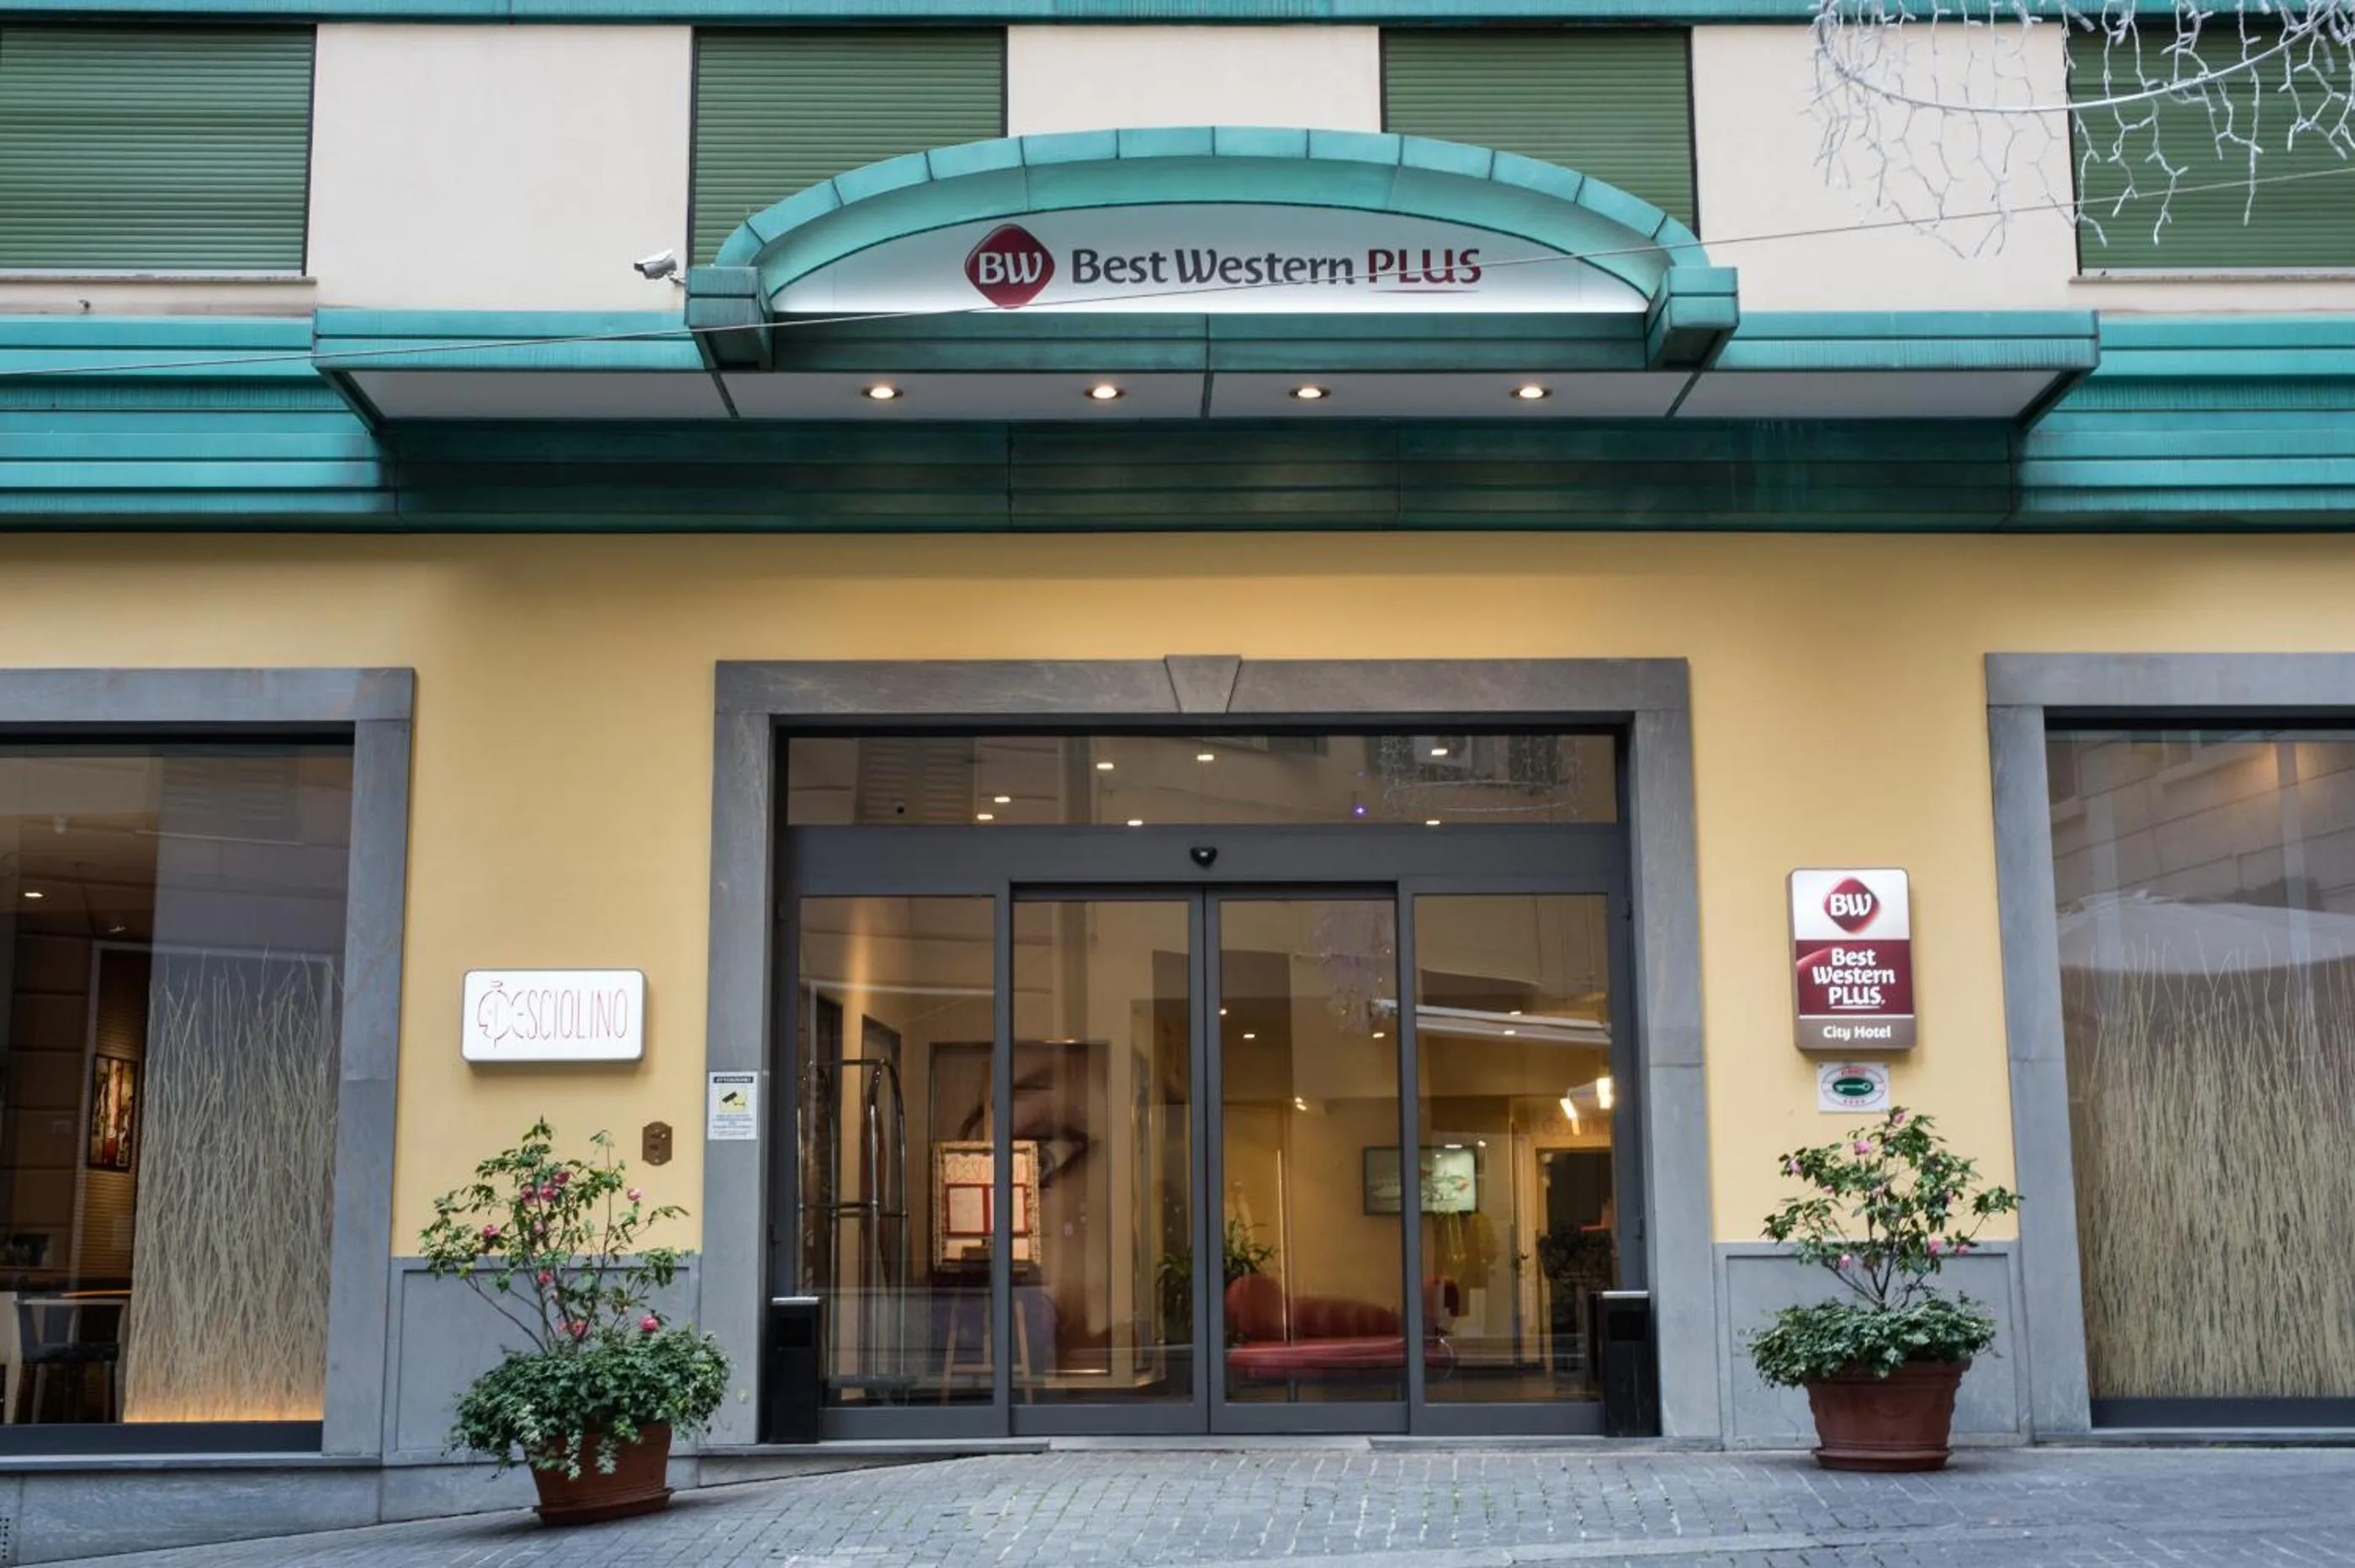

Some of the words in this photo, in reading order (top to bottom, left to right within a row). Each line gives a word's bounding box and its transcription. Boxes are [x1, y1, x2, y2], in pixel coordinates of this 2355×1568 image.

[979, 251, 1045, 285] BW
[1071, 248, 1168, 284] Best
[1173, 248, 1355, 285] Western
[1367, 247, 1482, 284] PLUS
[1829, 893, 1873, 918] BW
[1831, 947, 1877, 967] Best
[1812, 967, 1896, 985] Western
[1822, 1025, 1851, 1041] City
[1854, 1025, 1892, 1040] Hotel
